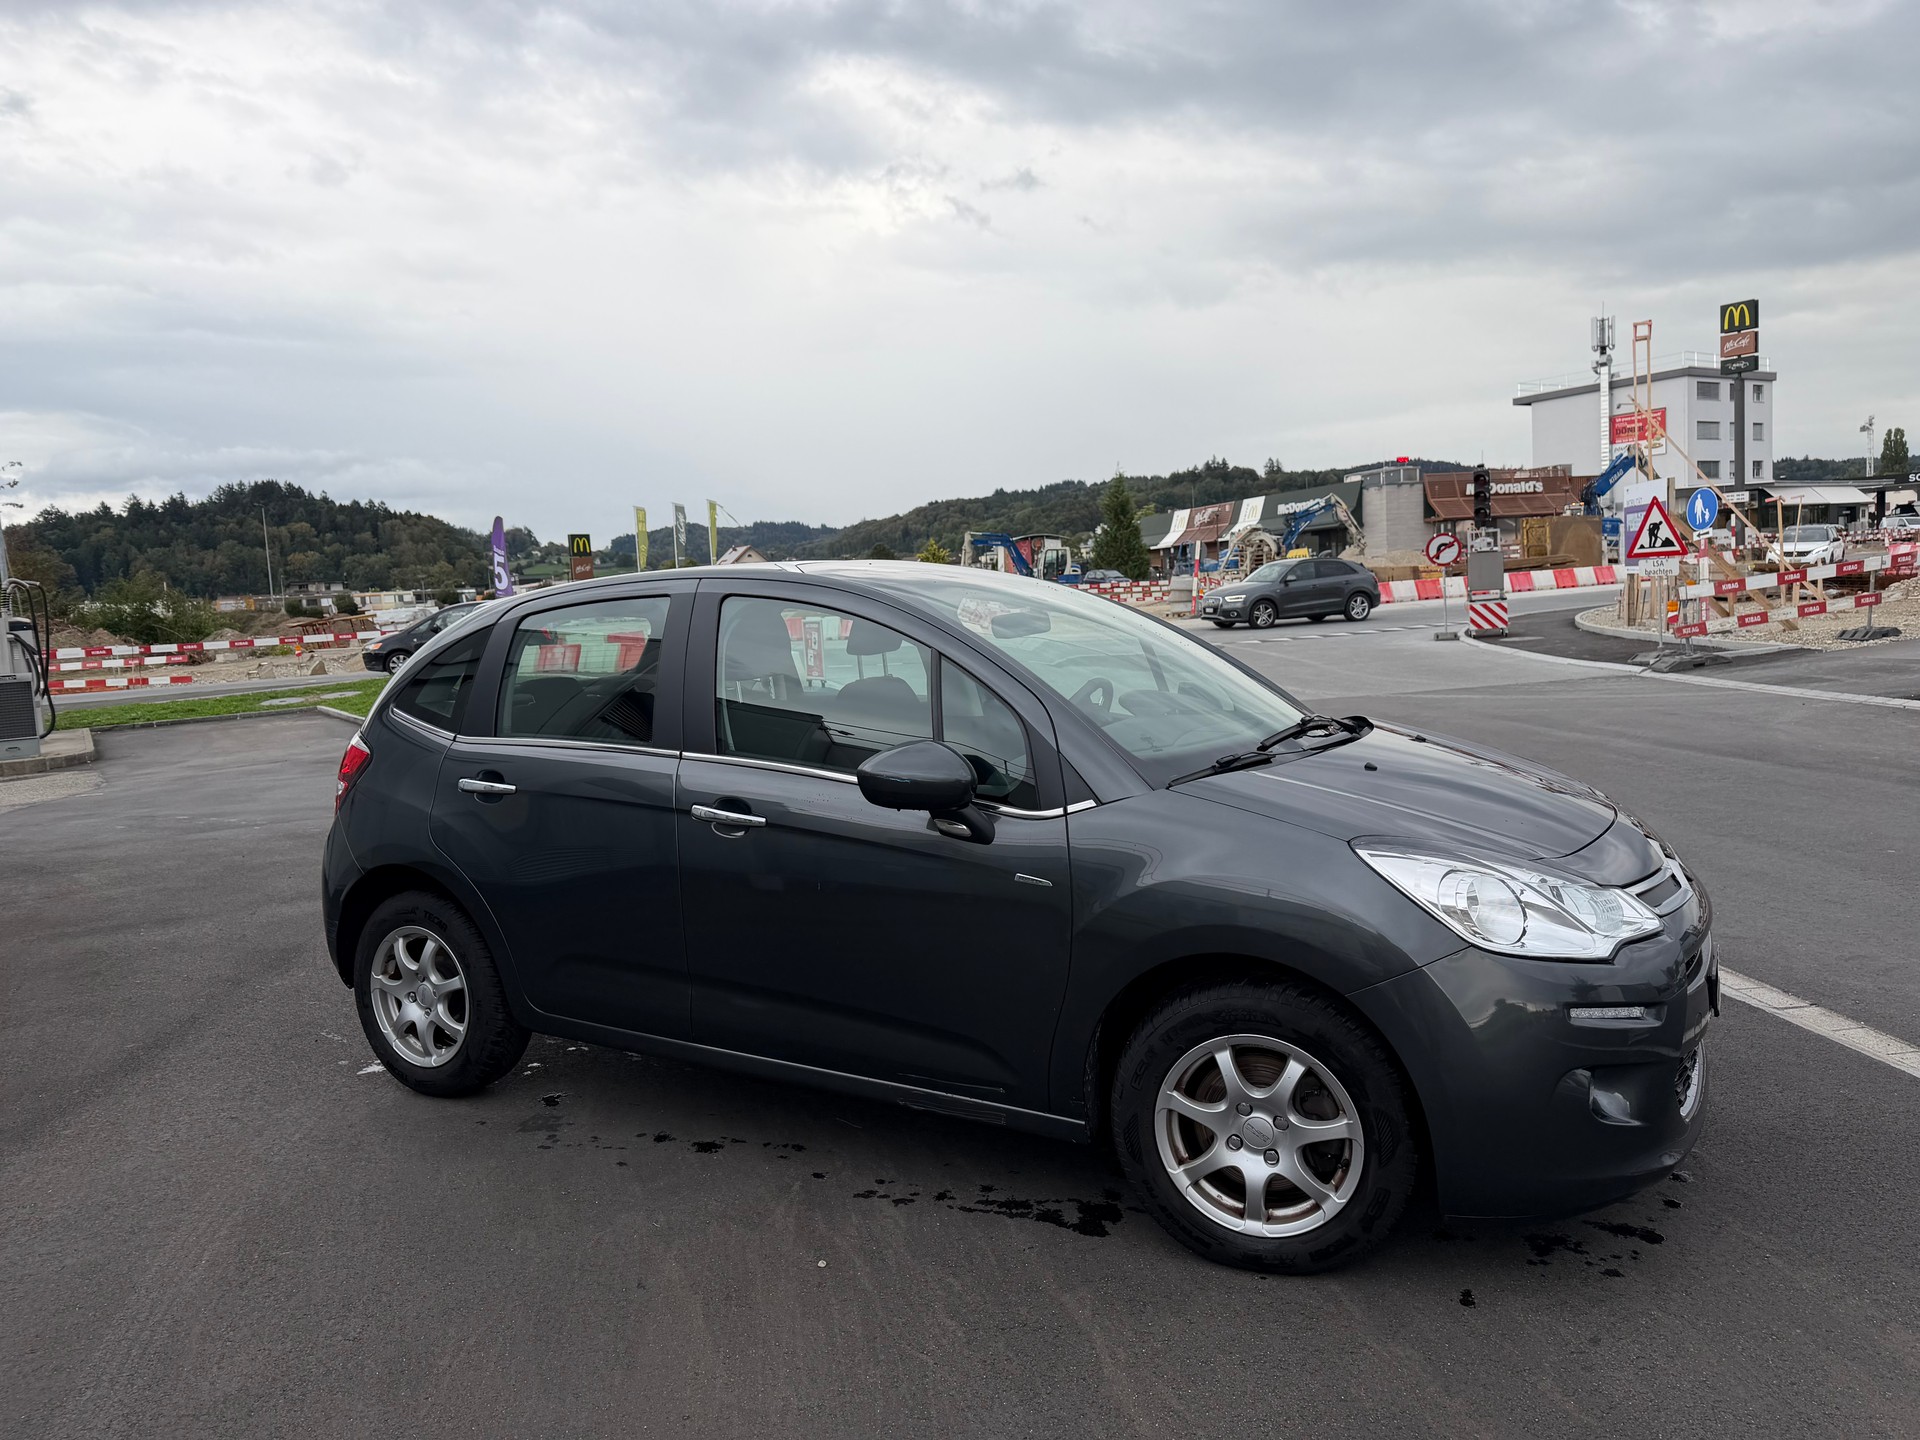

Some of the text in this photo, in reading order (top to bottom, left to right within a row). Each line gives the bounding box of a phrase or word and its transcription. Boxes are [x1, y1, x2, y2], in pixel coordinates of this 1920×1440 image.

[1465, 480, 1544, 496] MDonald's
[494, 552, 509, 590] 5
[1644, 567, 1673, 576] beachten
[1722, 582, 1739, 590] KIBAG
[1784, 572, 1801, 580] KIBAG
[1898, 555, 1912, 563] KIBAG
[1745, 615, 1761, 623] KIBAG
[1861, 596, 1876, 604] KIBAG
